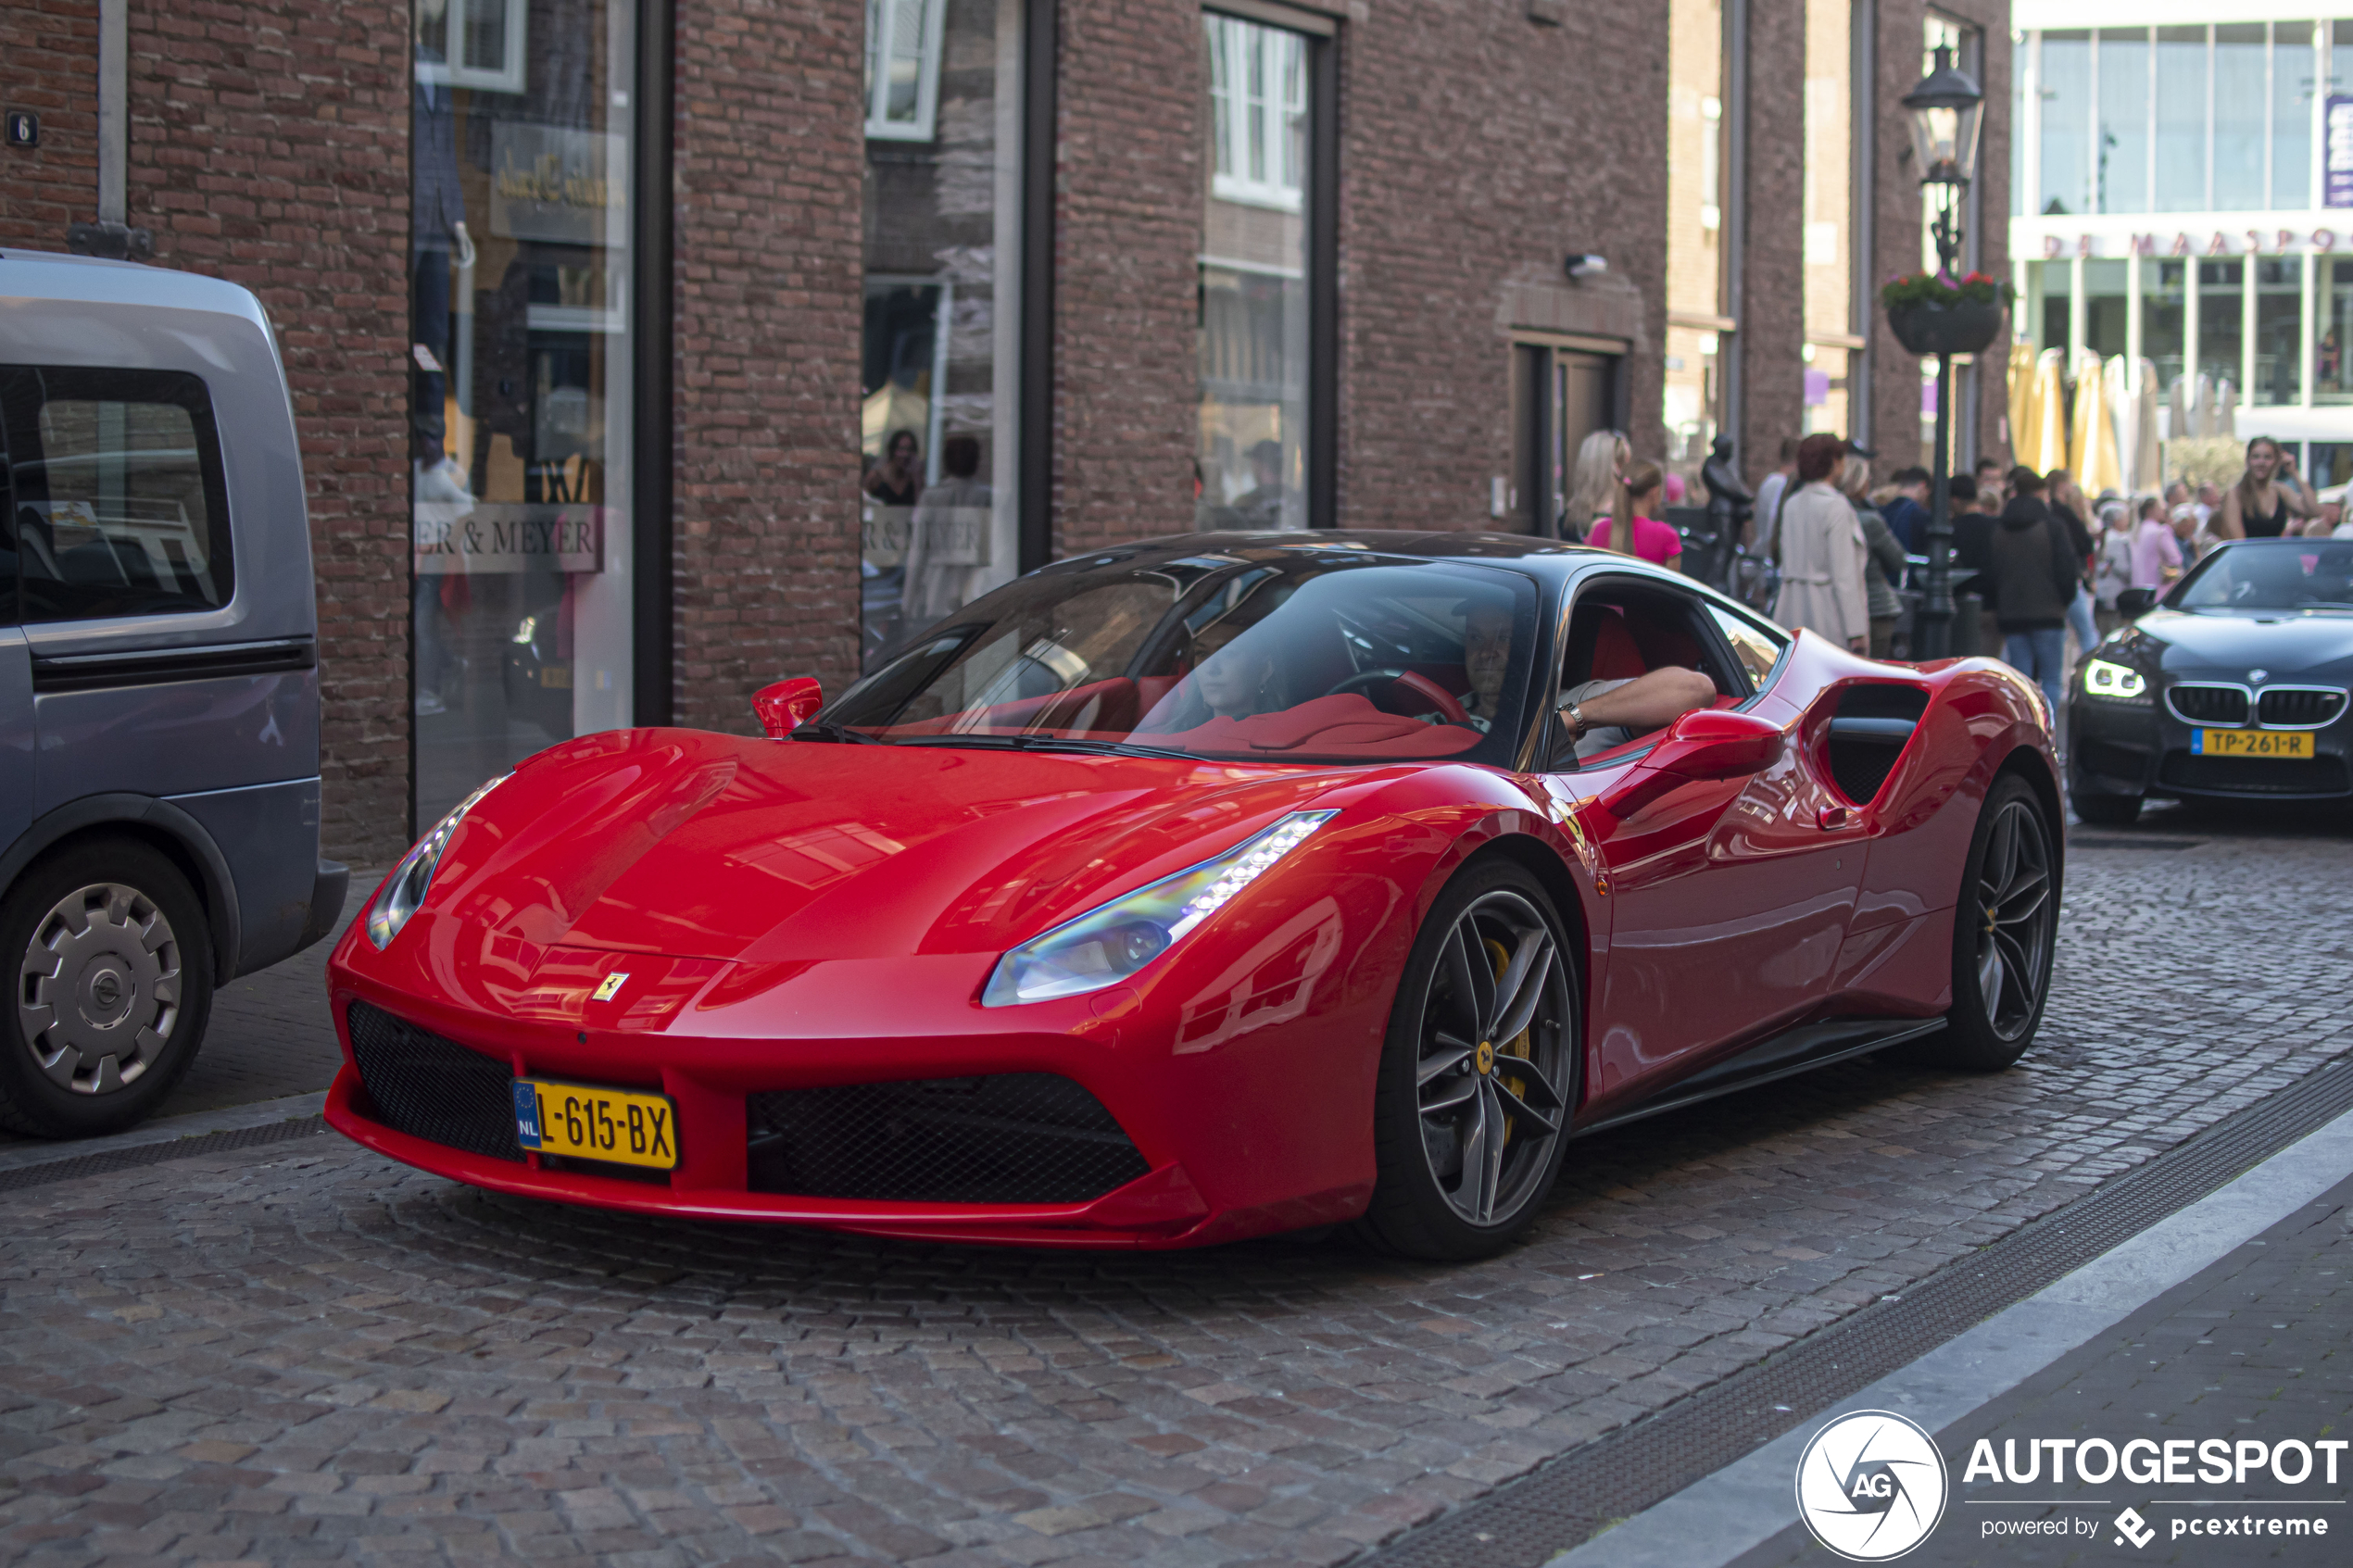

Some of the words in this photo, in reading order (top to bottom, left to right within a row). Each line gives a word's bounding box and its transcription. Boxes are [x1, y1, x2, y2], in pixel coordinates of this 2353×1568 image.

[19, 116, 29, 141] 6
[2132, 228, 2353, 257] MAASPO
[464, 521, 484, 555] &
[492, 521, 594, 555] MEYER
[2213, 734, 2301, 755] TP-261-R
[519, 1120, 538, 1136] NL
[536, 1093, 671, 1158] L-615-BX
